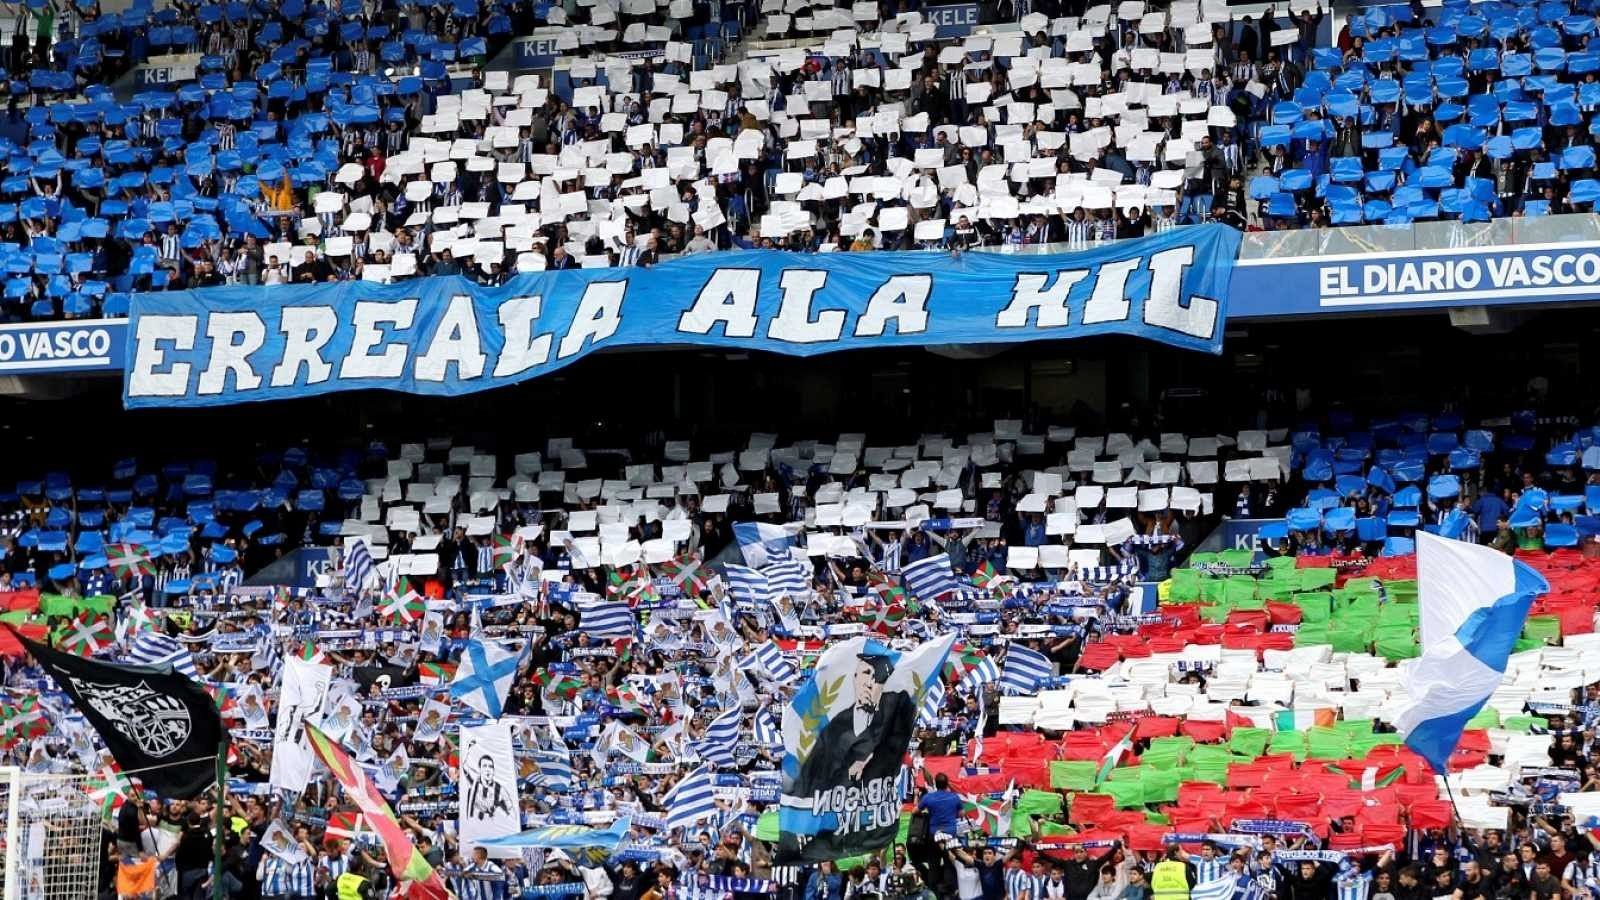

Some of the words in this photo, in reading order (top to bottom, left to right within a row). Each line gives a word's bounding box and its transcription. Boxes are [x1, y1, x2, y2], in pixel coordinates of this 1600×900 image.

[524, 39, 562, 57] KEL
[1320, 266, 1359, 296] EL
[1363, 259, 1482, 293] DIARIO
[1485, 252, 1600, 288] VASCO
[127, 279, 628, 397] ERREALA
[676, 267, 933, 343] ALA
[995, 245, 1218, 341] HIL
[19, 329, 111, 360] VASCO
